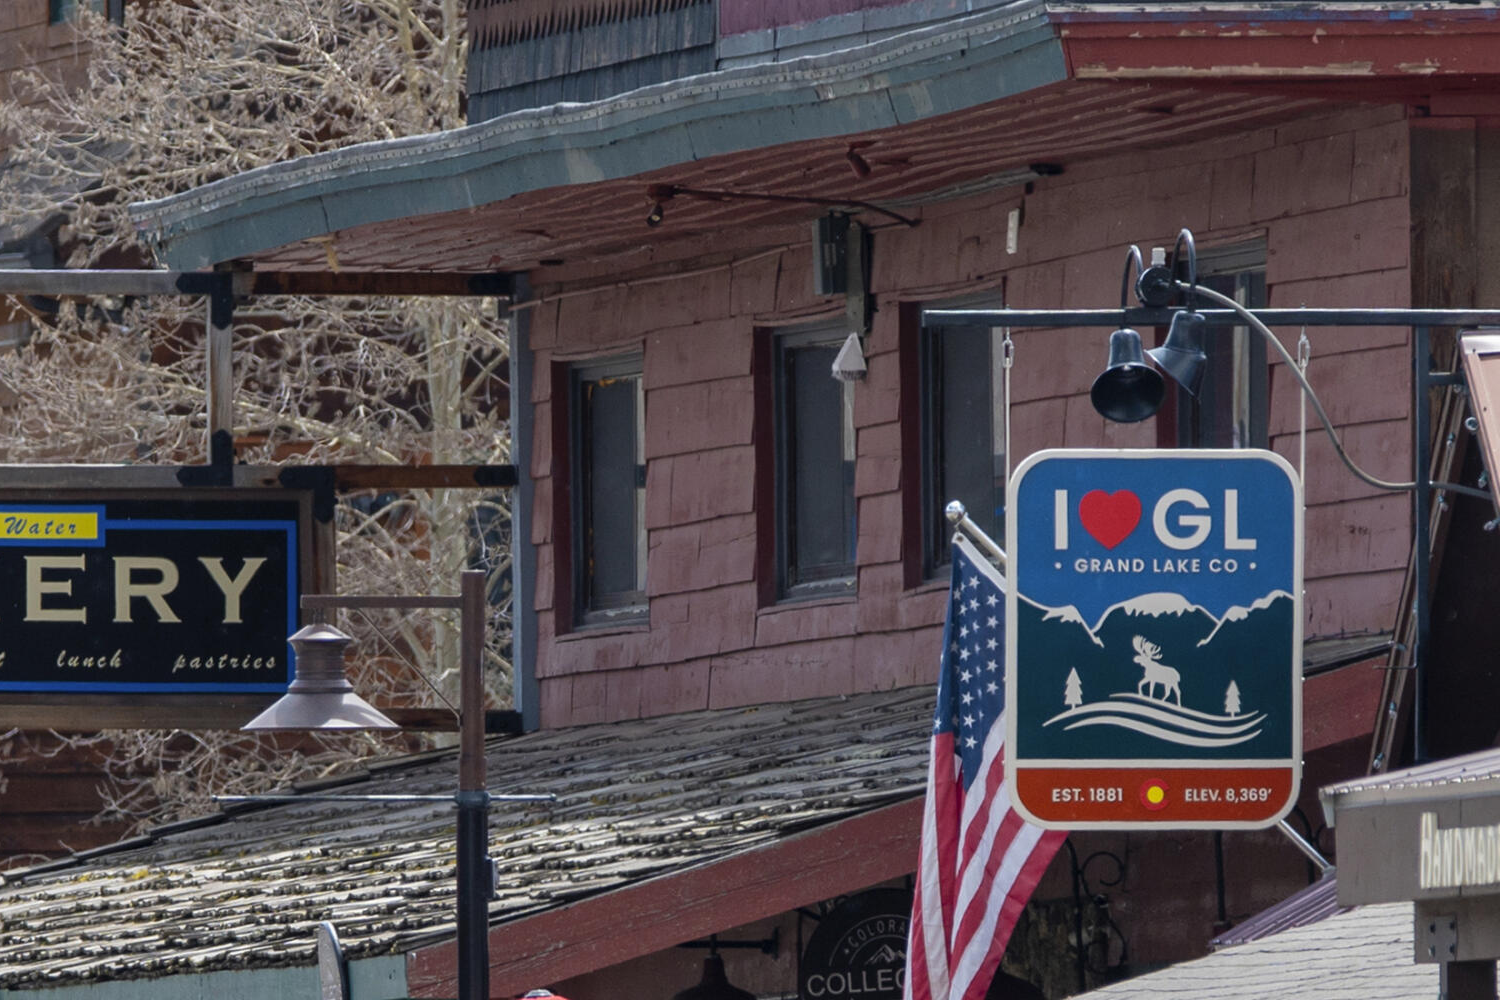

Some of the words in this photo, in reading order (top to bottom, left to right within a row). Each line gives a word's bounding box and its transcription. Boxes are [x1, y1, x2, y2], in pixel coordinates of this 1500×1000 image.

[4, 511, 77, 535] Water
[1055, 489, 1069, 551] I
[1152, 488, 1258, 551] GL
[1074, 558, 1145, 573] GRAND
[1153, 558, 1201, 573] LAKE
[1209, 558, 1238, 573] CO
[56, 649, 123, 669] lunch
[171, 653, 277, 674] pastries
[1052, 788, 1085, 802] EST.
[1089, 788, 1123, 802] 1881
[1184, 788, 1222, 802] ELEV.
[847, 918, 907, 950] COLORA
